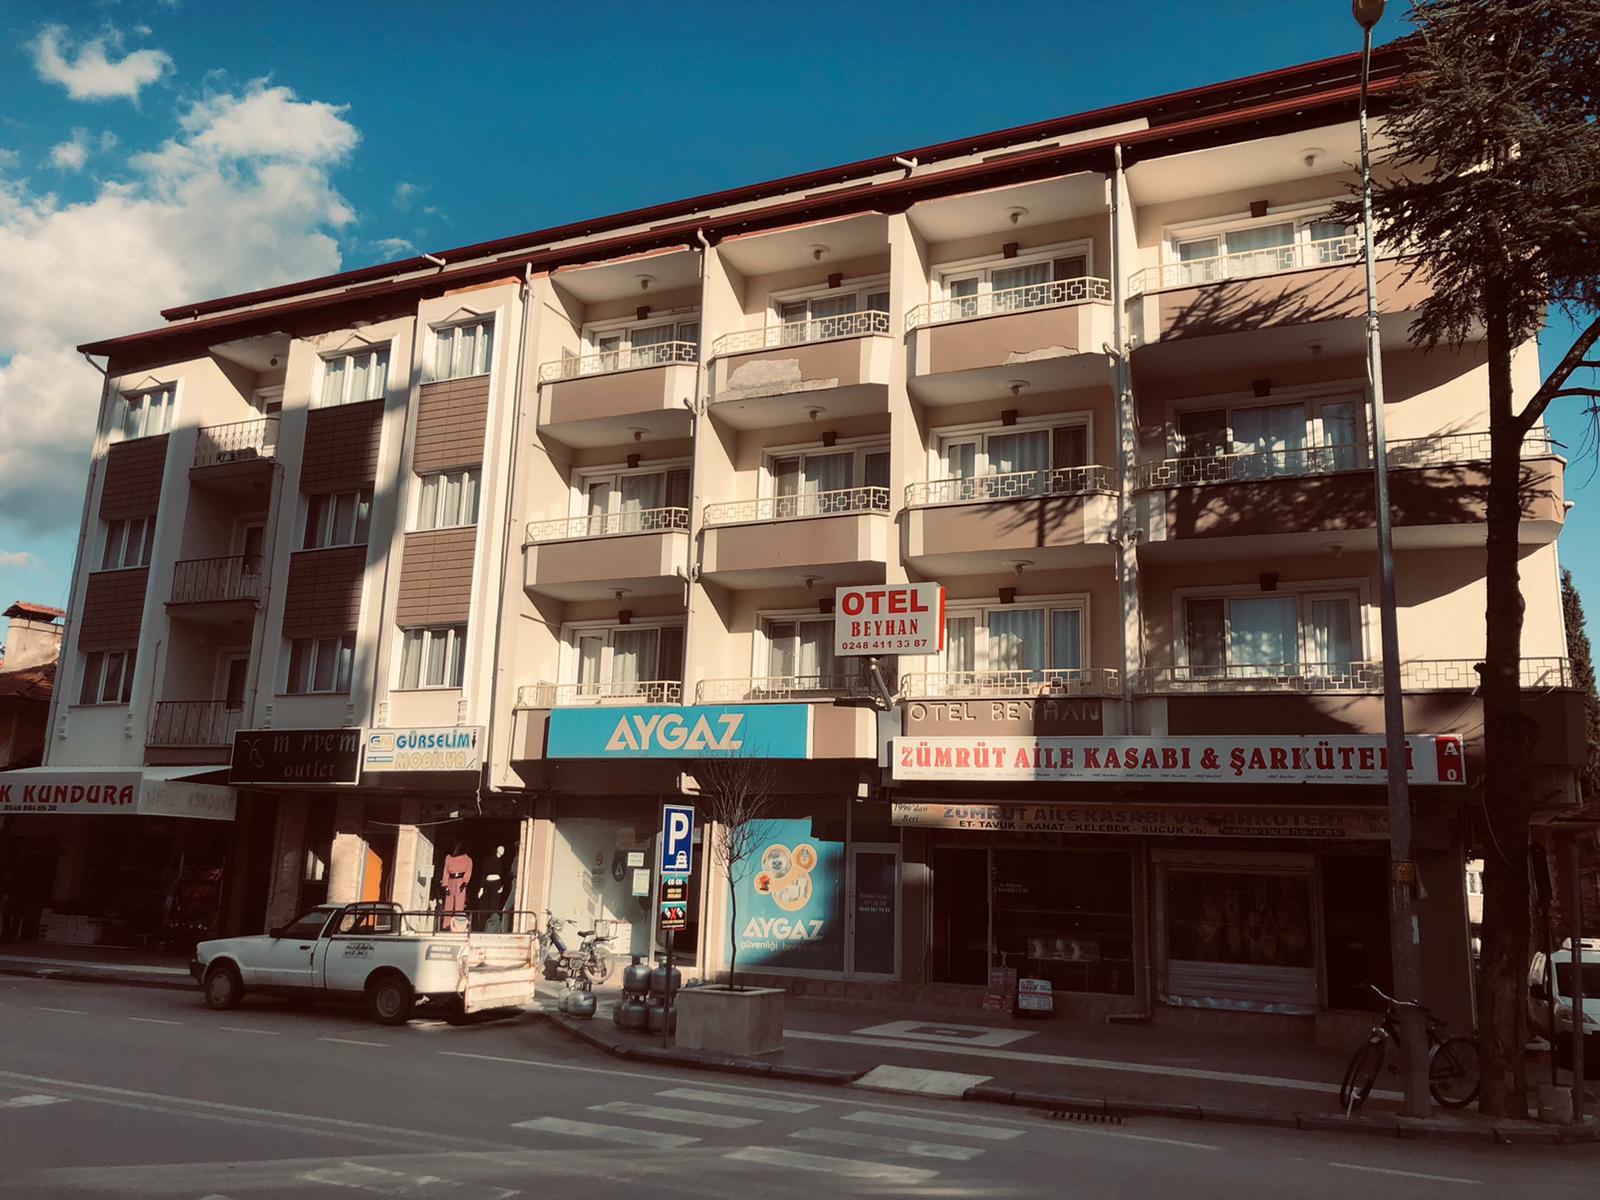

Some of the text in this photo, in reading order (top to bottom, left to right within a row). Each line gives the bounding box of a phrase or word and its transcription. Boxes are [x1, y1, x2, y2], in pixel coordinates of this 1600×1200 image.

[842, 589, 928, 616] OTEL
[851, 619, 918, 637] BEYHAN
[842, 639, 927, 650] 0248 411 33 87
[910, 700, 1099, 721] OTEL BEYHAN
[396, 729, 470, 749] GÜRSELİM
[604, 713, 746, 751] AYGAZ
[394, 748, 467, 769] MOBİLYA
[901, 741, 1007, 769] ZÜMRÜT
[1013, 741, 1074, 769] AİLE
[1083, 747, 1191, 769] KASABI
[1200, 746, 1221, 769] &
[1444, 742, 1459, 755] A
[283, 760, 335, 778] outlet
[23, 784, 134, 806] KUNDURA
[902, 814, 920, 823] Beri
[979, 821, 1016, 830] TAVUK
[1026, 823, 1065, 831] KANAT
[1075, 823, 1130, 833] KELEBEK
[1141, 825, 1185, 834] SUCUK
[668, 812, 689, 855] P
[743, 916, 825, 941] AYGAZ
